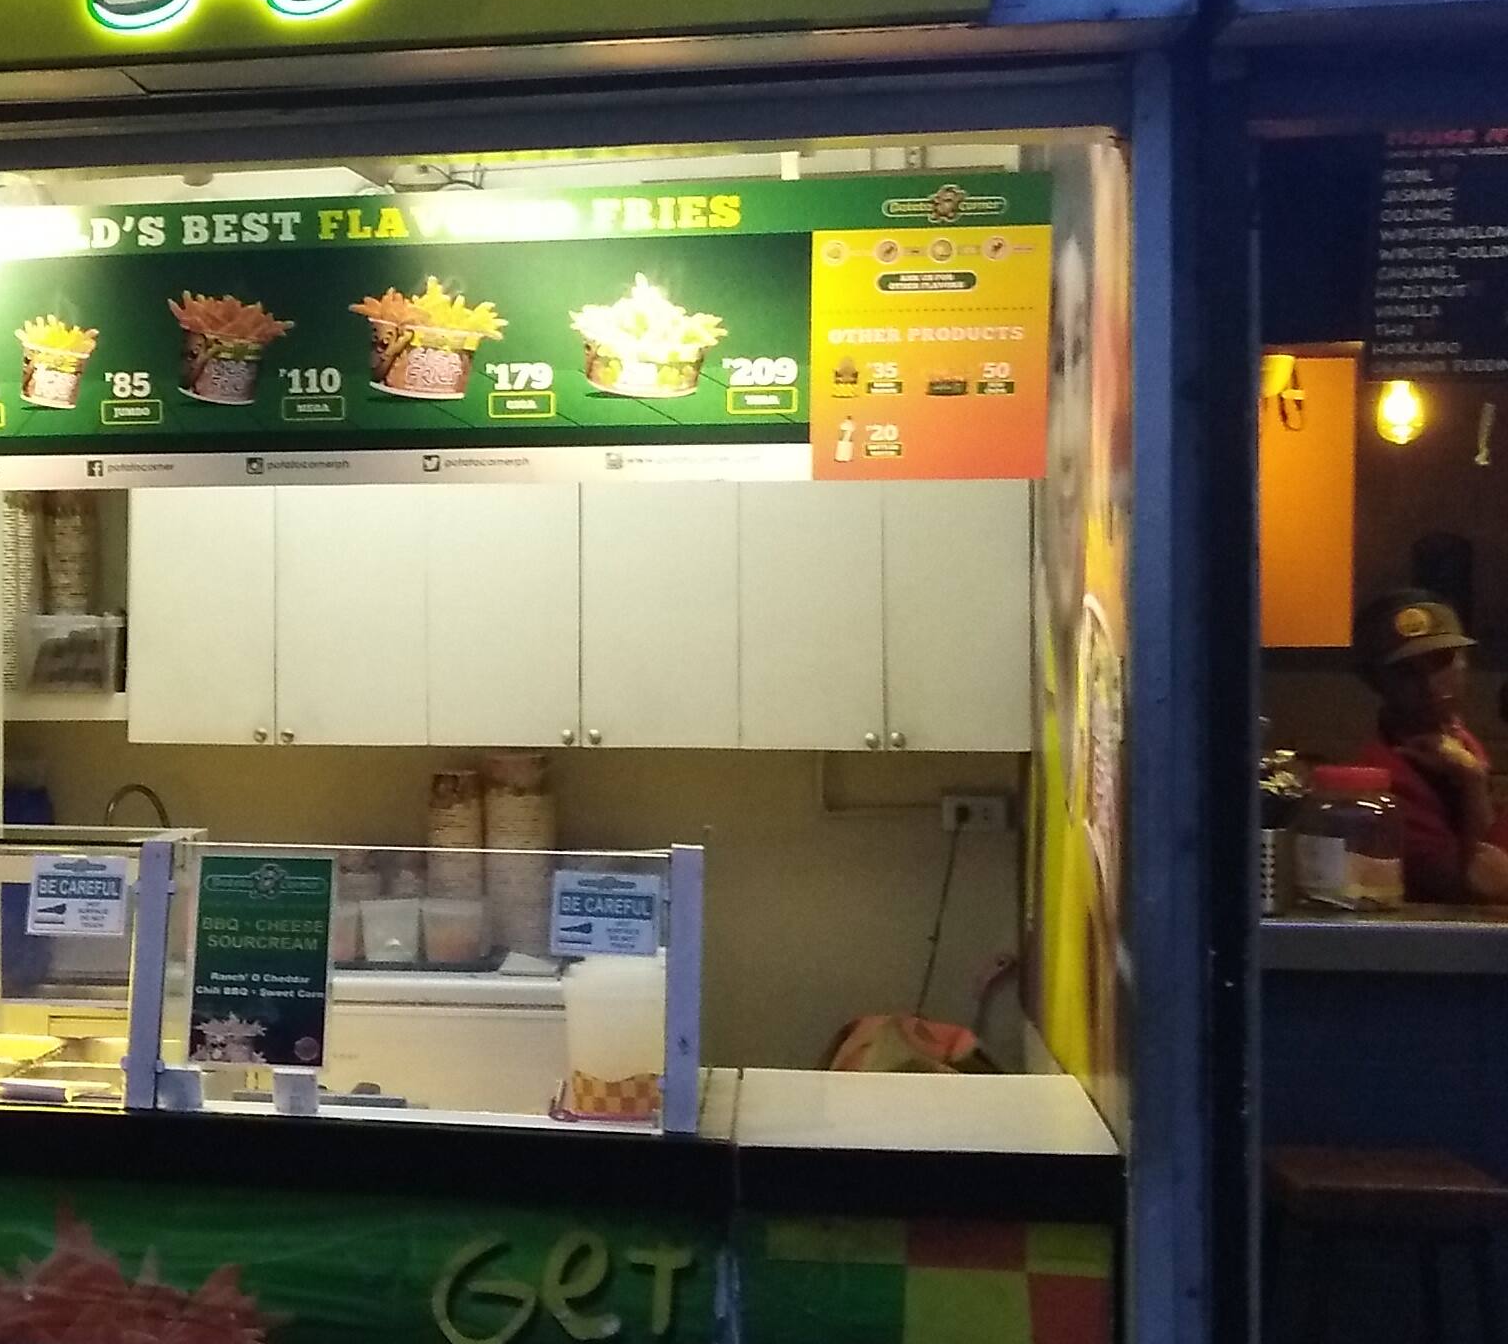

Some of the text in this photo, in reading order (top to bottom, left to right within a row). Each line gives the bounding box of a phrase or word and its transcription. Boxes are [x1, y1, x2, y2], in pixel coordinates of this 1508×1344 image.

[182, 211, 301, 244] BEST
[592, 194, 742, 232] FRIES
[907, 326, 1024, 342] PRODUCTS
[39, 878, 119, 896] BE CAREFUL
[562, 896, 650, 915] BE CAREFUL
[202, 917, 324, 933] BBQ CHEESE
[207, 934, 318, 951] SOURCREAM
[263, 973, 310, 984] Cheddar
